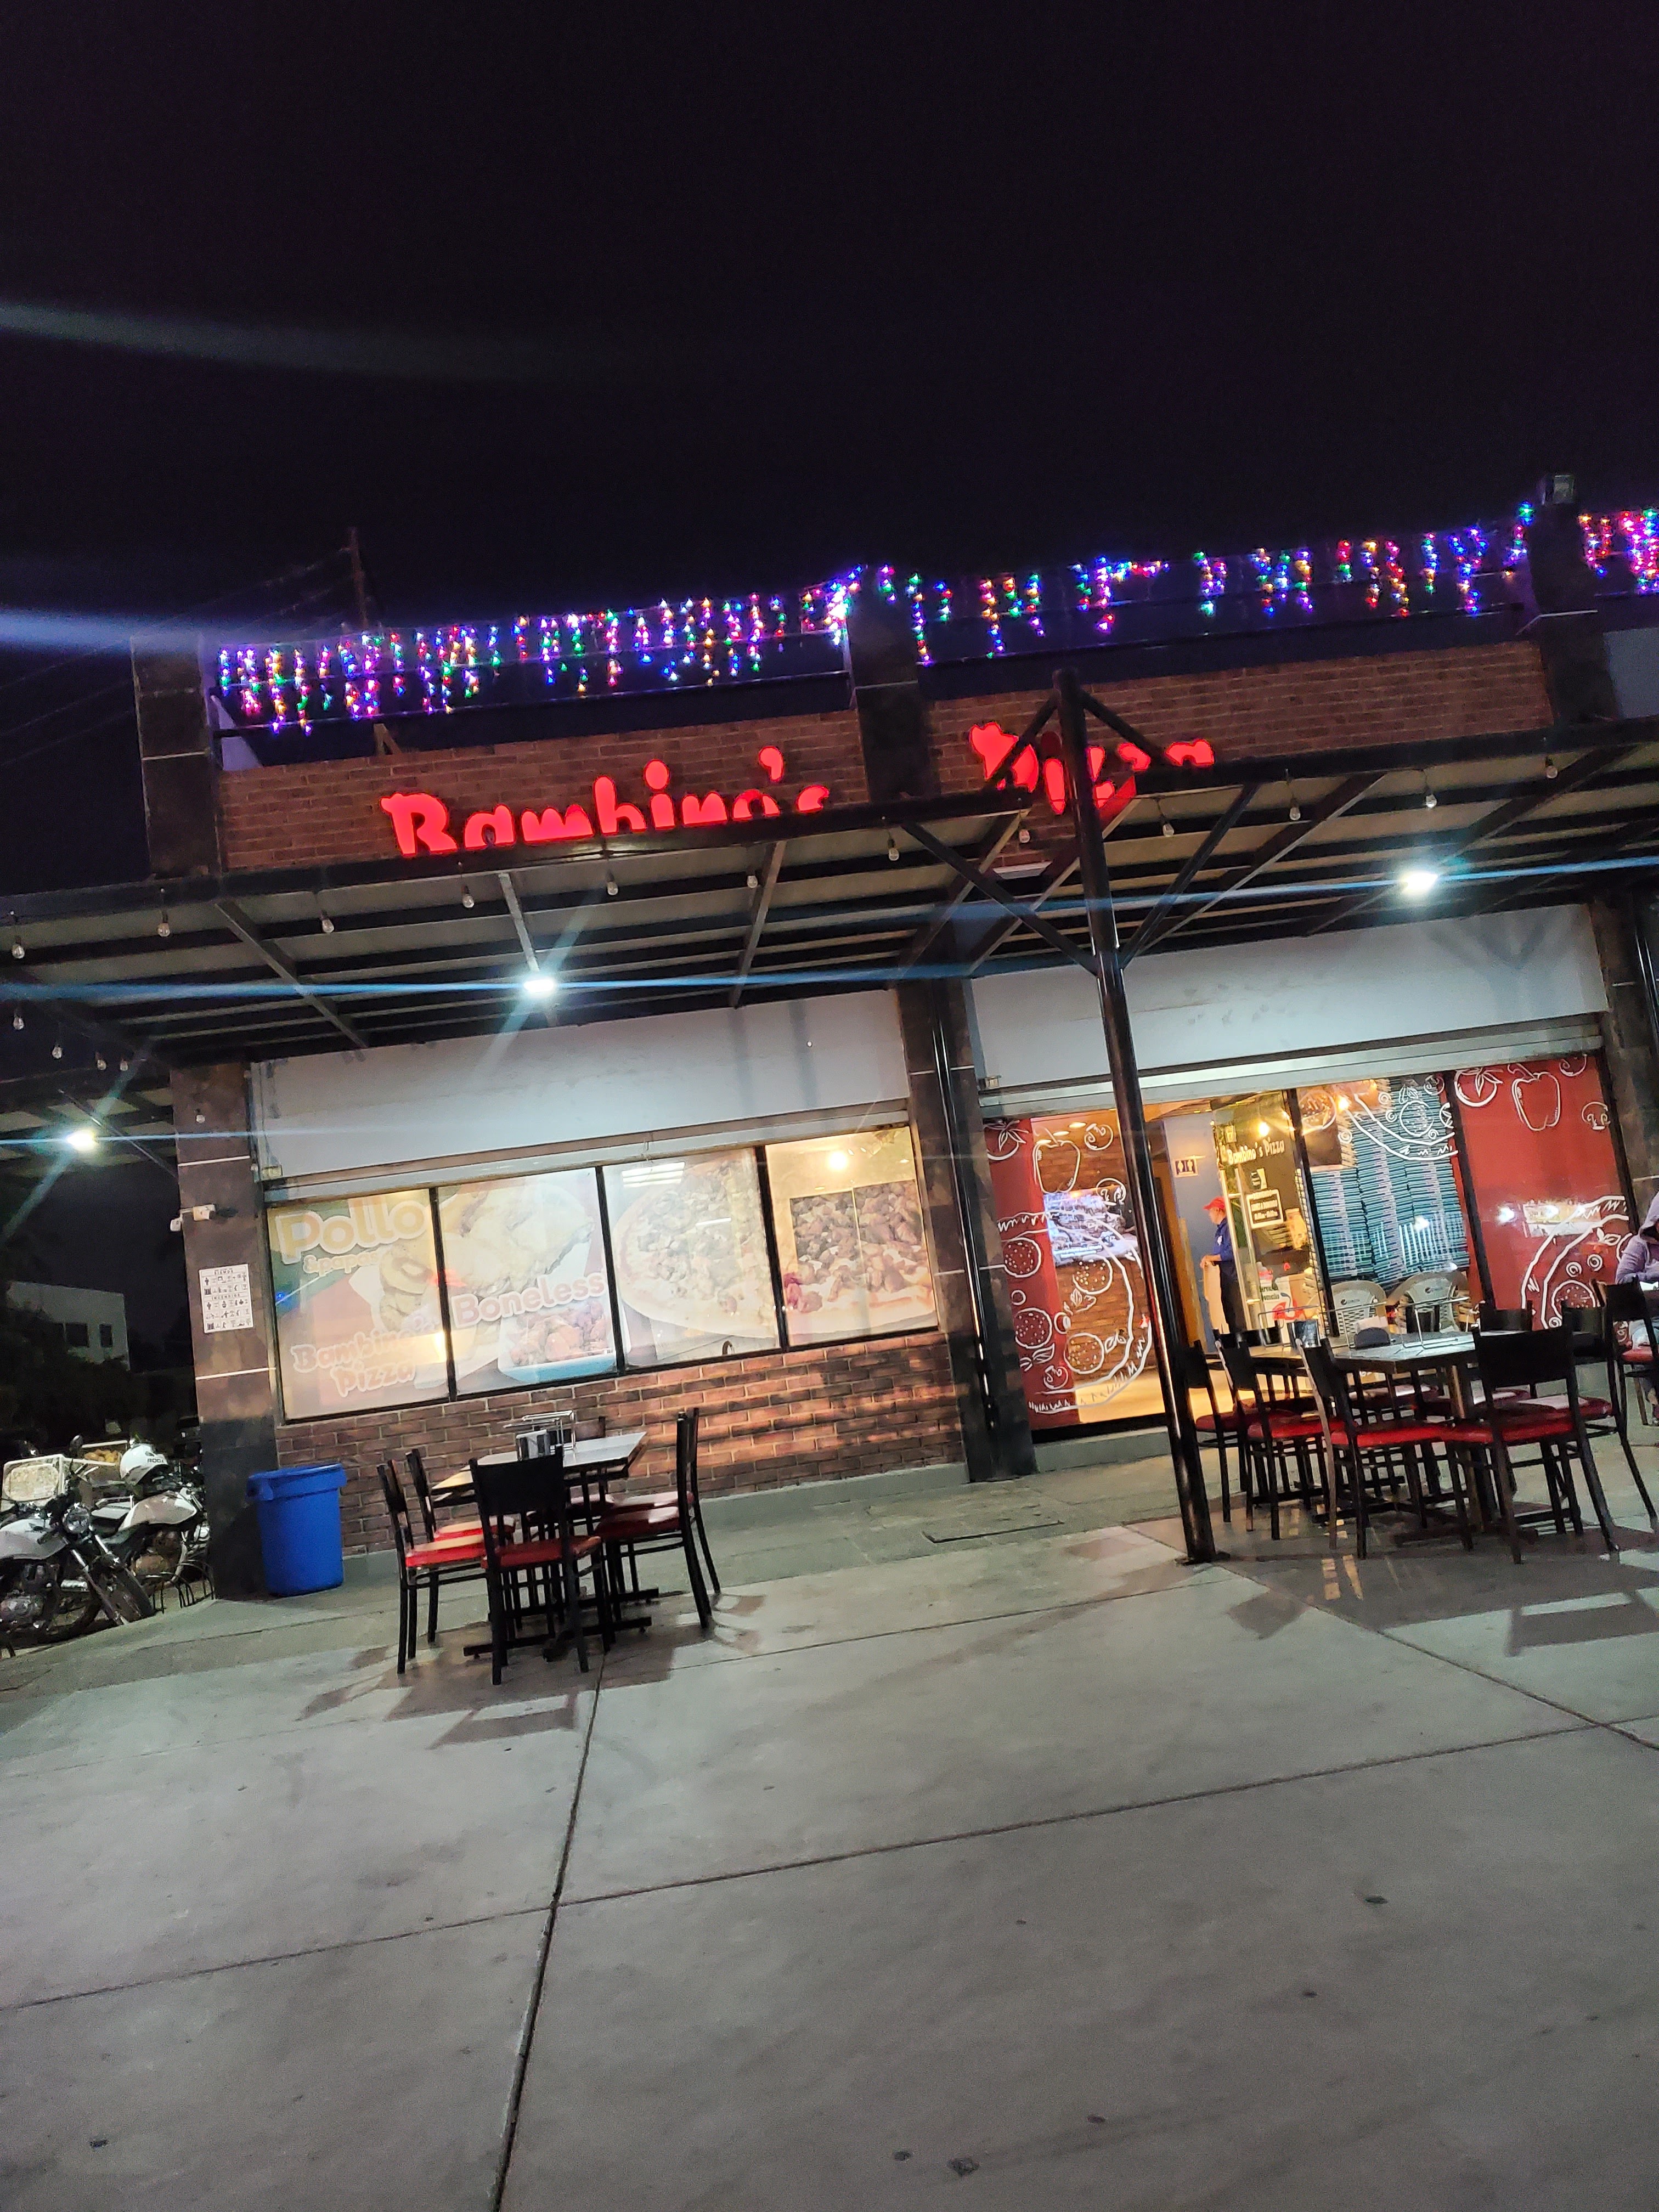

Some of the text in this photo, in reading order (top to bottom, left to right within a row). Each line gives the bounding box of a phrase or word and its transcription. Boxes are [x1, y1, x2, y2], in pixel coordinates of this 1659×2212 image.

[1227, 1137, 1285, 1165] Bambino's Pizza
[277, 1196, 426, 1263] Pollo
[452, 1273, 607, 1327] Boneless
[331, 1361, 415, 1397] Pizza
